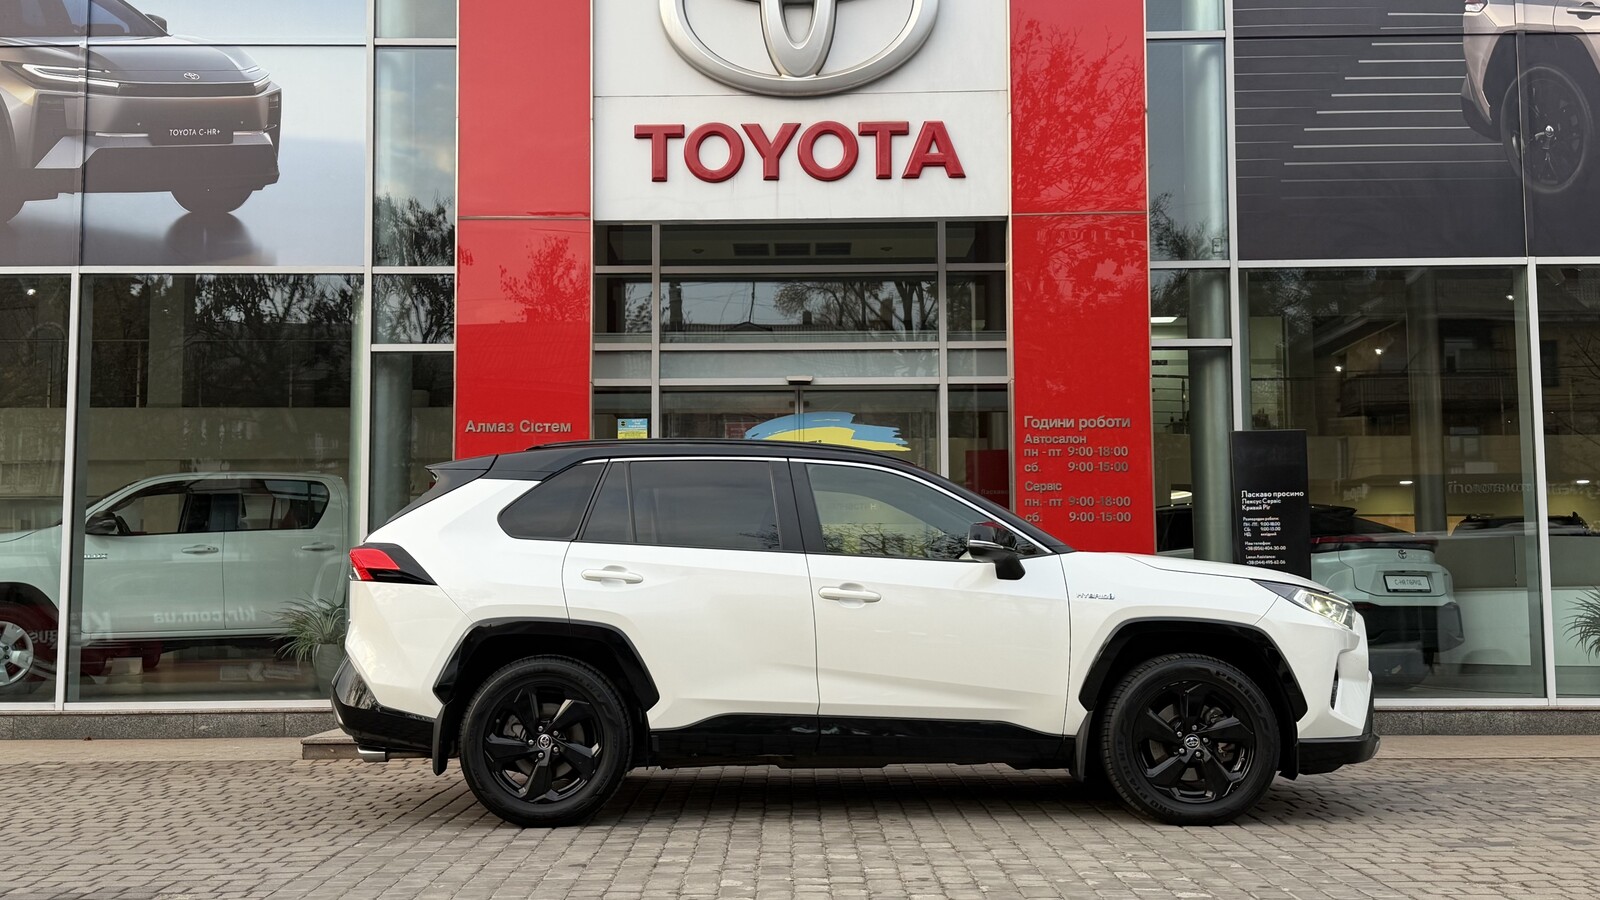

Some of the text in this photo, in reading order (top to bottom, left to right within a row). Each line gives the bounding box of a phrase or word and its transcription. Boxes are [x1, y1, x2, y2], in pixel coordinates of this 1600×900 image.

[169, 128, 221, 137] TOYOTA C-HR+
[634, 120, 967, 183] TOYOTA
[464, 419, 572, 433] Алмаз Сістем
[1023, 415, 1131, 430] Години роботи
[1023, 433, 1087, 445] Автосалон
[1067, 446, 1129, 457] 9:00-18:00
[1024, 461, 1129, 472] сб. 9:00-15:00
[1024, 480, 1063, 492] Сервіс
[1068, 496, 1131, 507] 9:00-18:00
[1025, 511, 1132, 522] сб. 9:00-15:00
